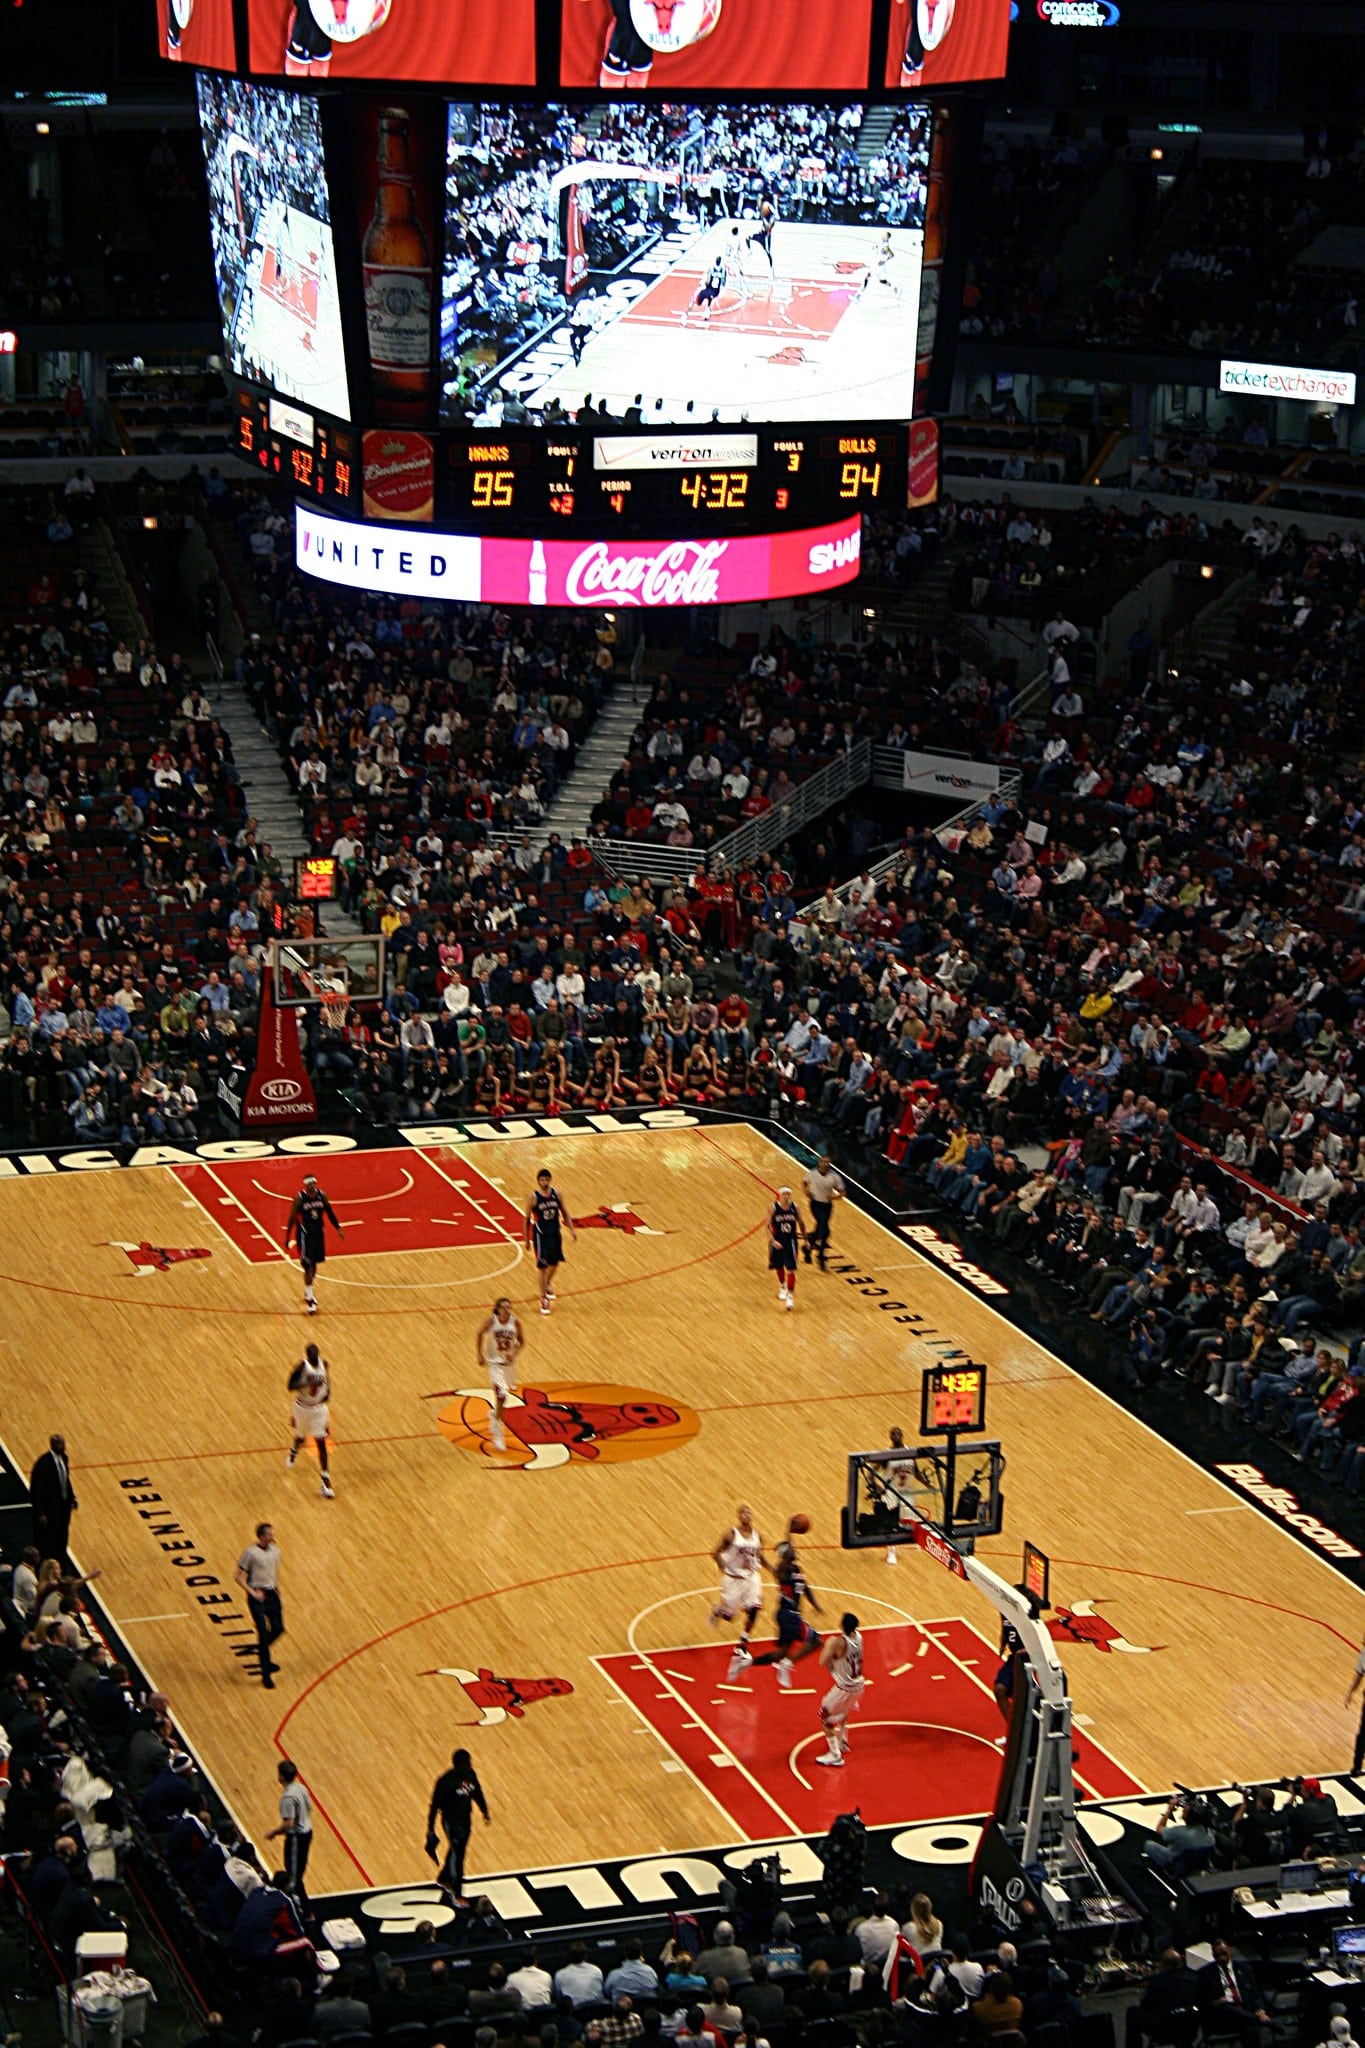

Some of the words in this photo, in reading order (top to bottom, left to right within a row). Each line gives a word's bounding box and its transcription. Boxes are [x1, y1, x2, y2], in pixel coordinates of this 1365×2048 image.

[1042, 1, 1099, 15] comcast
[327, 22, 356, 36] BULLS
[648, 33, 680, 45] BULLS
[1225, 367, 1347, 399] ticketexchange
[468, 446, 510, 462] HAWKS
[547, 446, 578, 456] FOULS
[651, 445, 711, 462] verizon
[774, 442, 804, 451] FOULS
[838, 438, 876, 453] BULLS
[364, 459, 431, 482] Budweiser
[566, 457, 574, 477] 1
[787, 453, 799, 472] 3
[471, 471, 515, 506] 95
[601, 481, 632, 492] PERIOD
[840, 462, 881, 498] 94
[681, 473, 748, 509] 4:32
[775, 488, 789, 510] 3
[611, 494, 624, 513] 4
[316, 535, 447, 578] UNITED
[566, 541, 729, 605] Coca-Cola
[302, 874, 331, 897] 22
[268, 1084, 295, 1097] KIA
[247, 1106, 267, 1117] KIA
[268, 1103, 314, 1115] MOTORS
[397, 1110, 700, 1146] BULLS
[781, 1222, 792, 1232] 10
[897, 1225, 1009, 1294] Bulls.com
[878, 1301, 971, 1359] NITED
[934, 1393, 974, 1425] 22
[1214, 1463, 1362, 1558] Bulls.com
[119, 1477, 206, 1568] CENTER
[1009, 1631, 1016, 1642] 2
